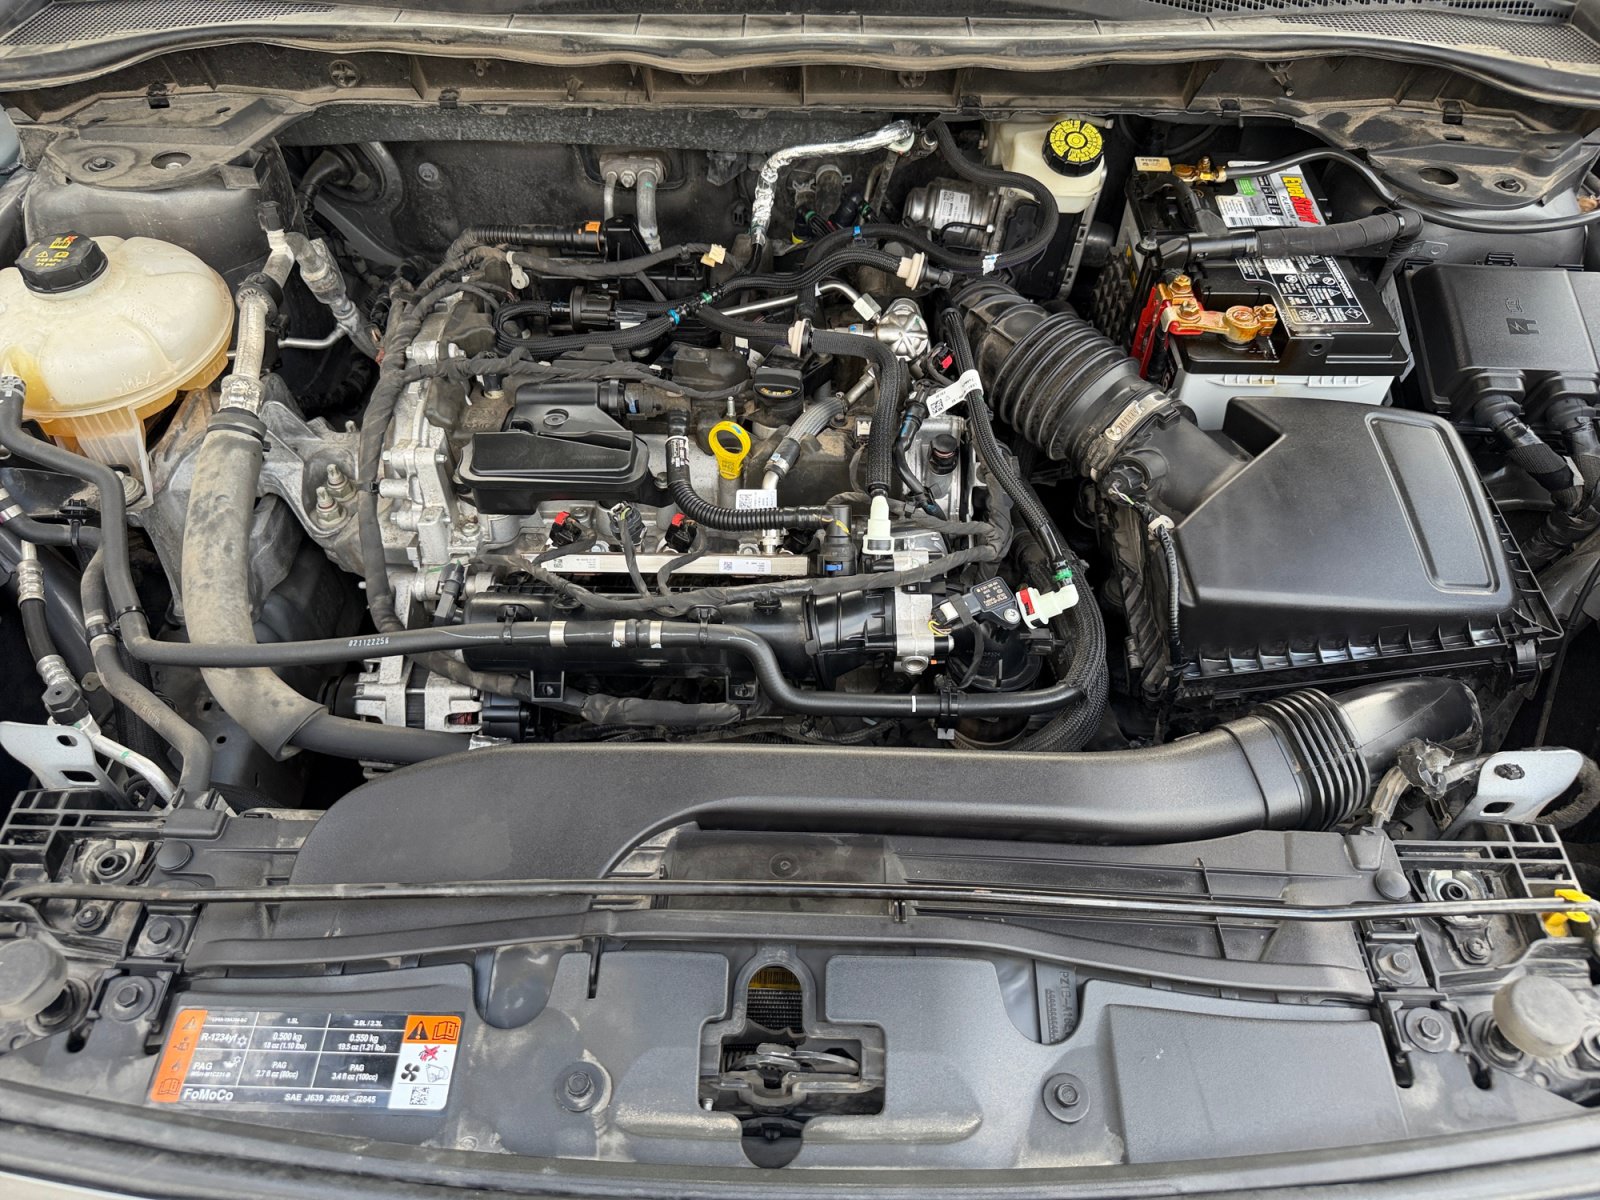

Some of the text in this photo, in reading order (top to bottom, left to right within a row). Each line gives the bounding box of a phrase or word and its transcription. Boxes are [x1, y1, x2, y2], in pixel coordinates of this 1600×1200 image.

[200, 1032, 237, 1043] R-1234yf
[273, 1032, 302, 1042] 0.500 kg
[349, 1033, 379, 1044] 0.550 kg
[193, 1062, 213, 1071] PAG
[272, 1061, 287, 1069] PAG
[349, 1063, 365, 1071] PAG
[183, 1088, 234, 1101] FoMoCo
[284, 1093, 303, 1101] SAE
[305, 1095, 324, 1103] J639
